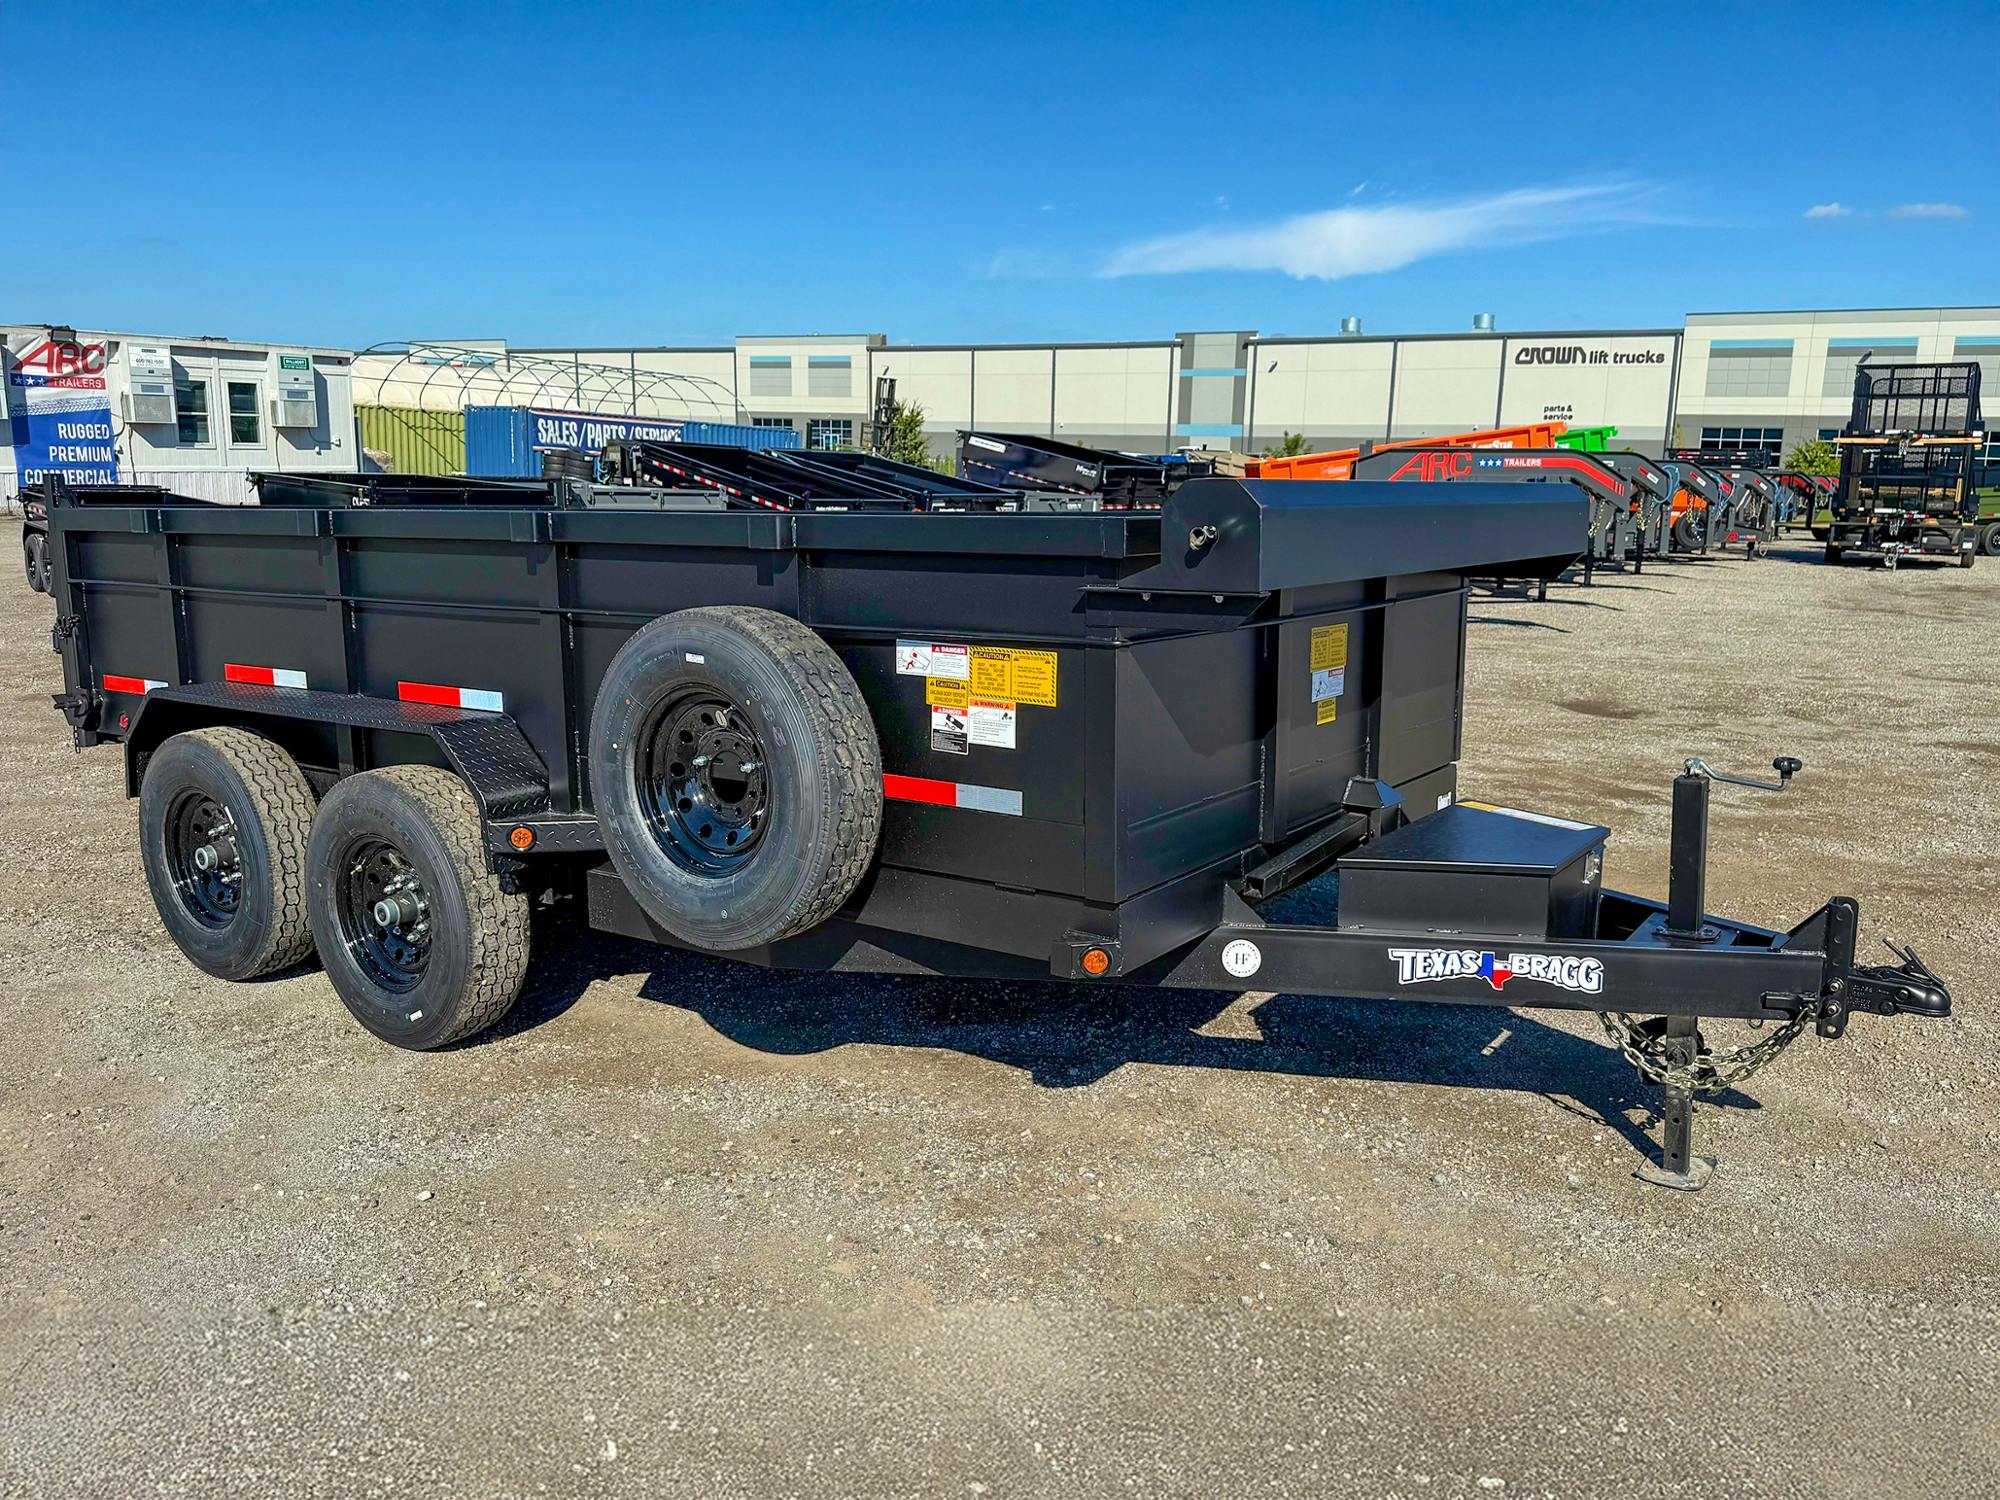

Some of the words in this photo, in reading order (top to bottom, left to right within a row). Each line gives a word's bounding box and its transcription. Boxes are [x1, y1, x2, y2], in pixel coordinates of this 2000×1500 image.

[11, 341, 105, 375] ARC
[1589, 350, 1609, 364] lift
[1613, 350, 1665, 364] trucks
[53, 377, 103, 388] TRAILERS
[58, 423, 110, 439] RUGGED
[49, 446, 113, 462] PREMIUM
[1387, 452, 1472, 482] ARC
[1504, 458, 1542, 467] TRAILERS
[24, 468, 115, 485] COERCIAL
[978, 651, 1004, 660] CAUTION
[1391, 950, 1480, 981] TEXAS
[1511, 954, 1603, 992] BRAGG
